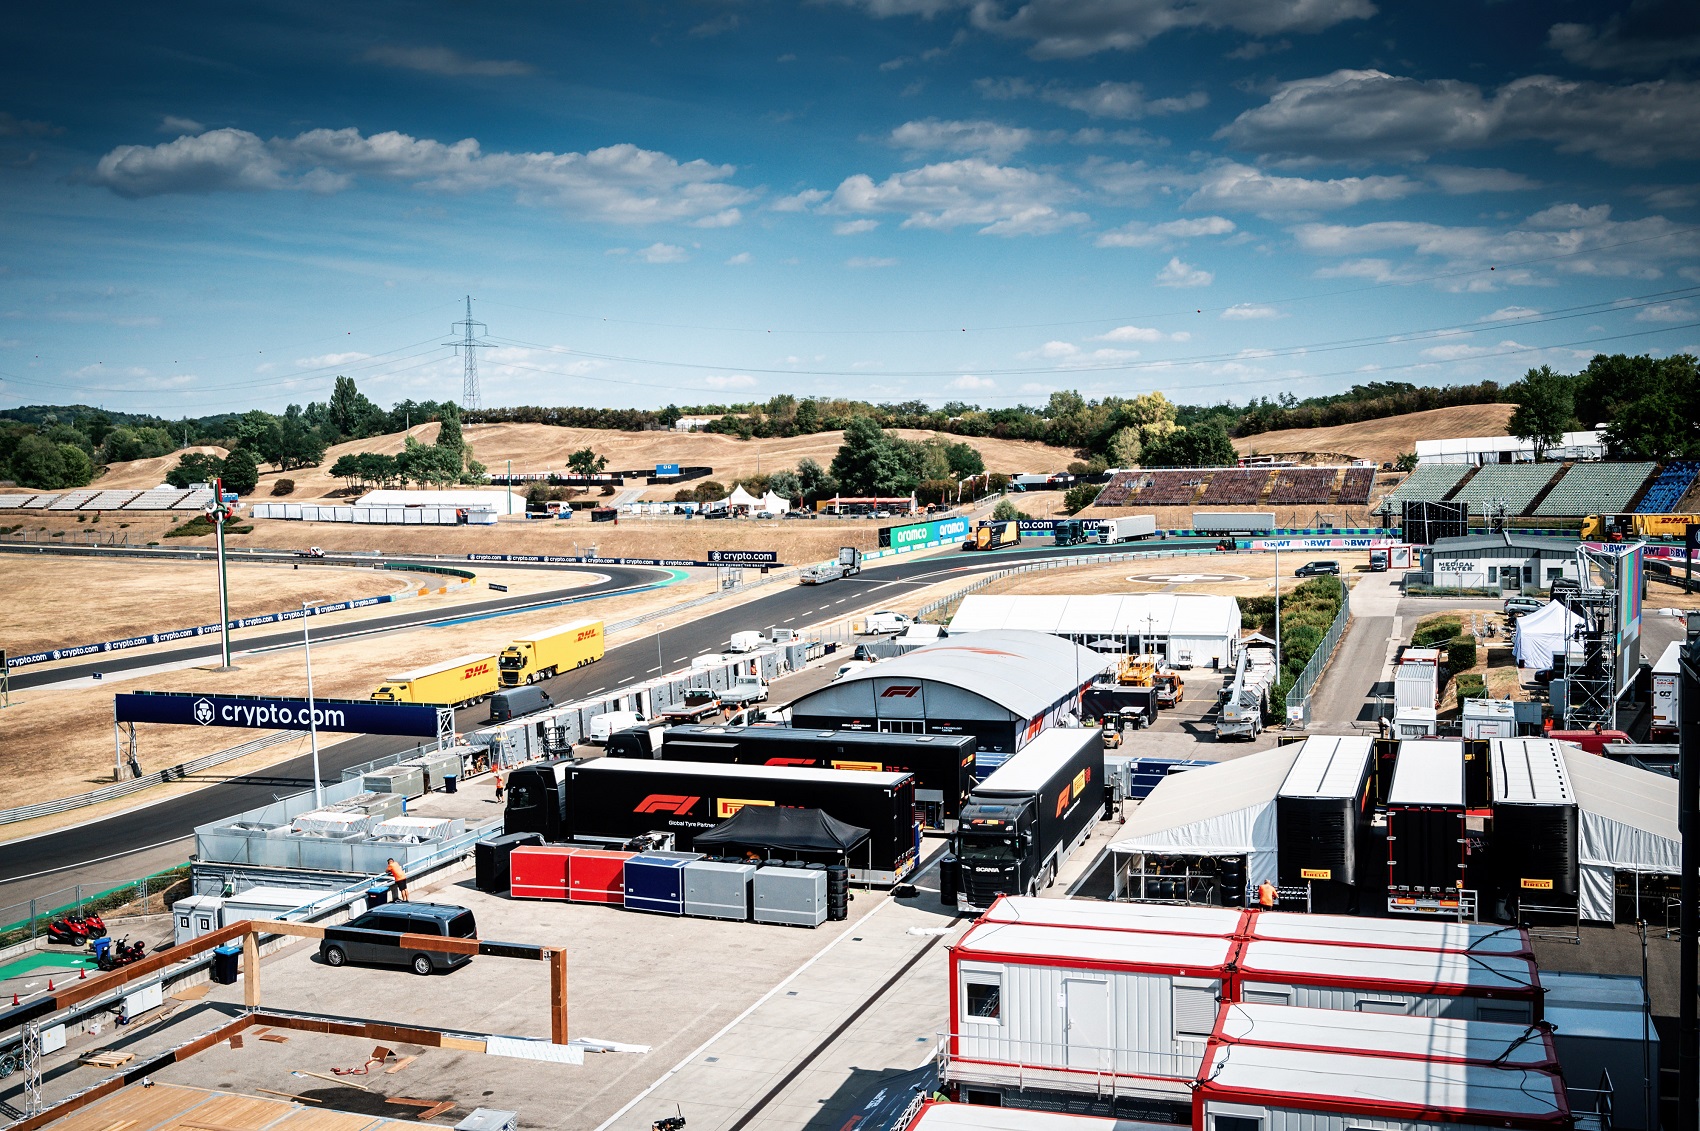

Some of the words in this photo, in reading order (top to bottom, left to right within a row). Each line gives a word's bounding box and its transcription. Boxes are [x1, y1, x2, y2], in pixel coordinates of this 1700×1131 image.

[939, 521, 965, 536] aramco
[1019, 520, 1053, 529] to.com
[897, 527, 927, 543] aramco
[1608, 544, 1627, 553] BWT
[1643, 547, 1660, 556] BWT
[1675, 549, 1687, 558] BW
[723, 552, 773, 561] crypto.com
[320, 603, 346, 613] crypto.com
[354, 598, 378, 607] crypto.com
[245, 615, 274, 626] crypto.com
[204, 622, 235, 634] cryptom
[159, 629, 193, 641] crypto.com
[577, 628, 597, 642] DHL
[112, 637, 148, 650] crypto.com
[62, 645, 99, 658] crypto.com
[7, 652, 47, 667] crypto.com
[465, 663, 490, 680] DHL
[221, 703, 345, 727] crypto.com
[633, 793, 701, 816] F1
